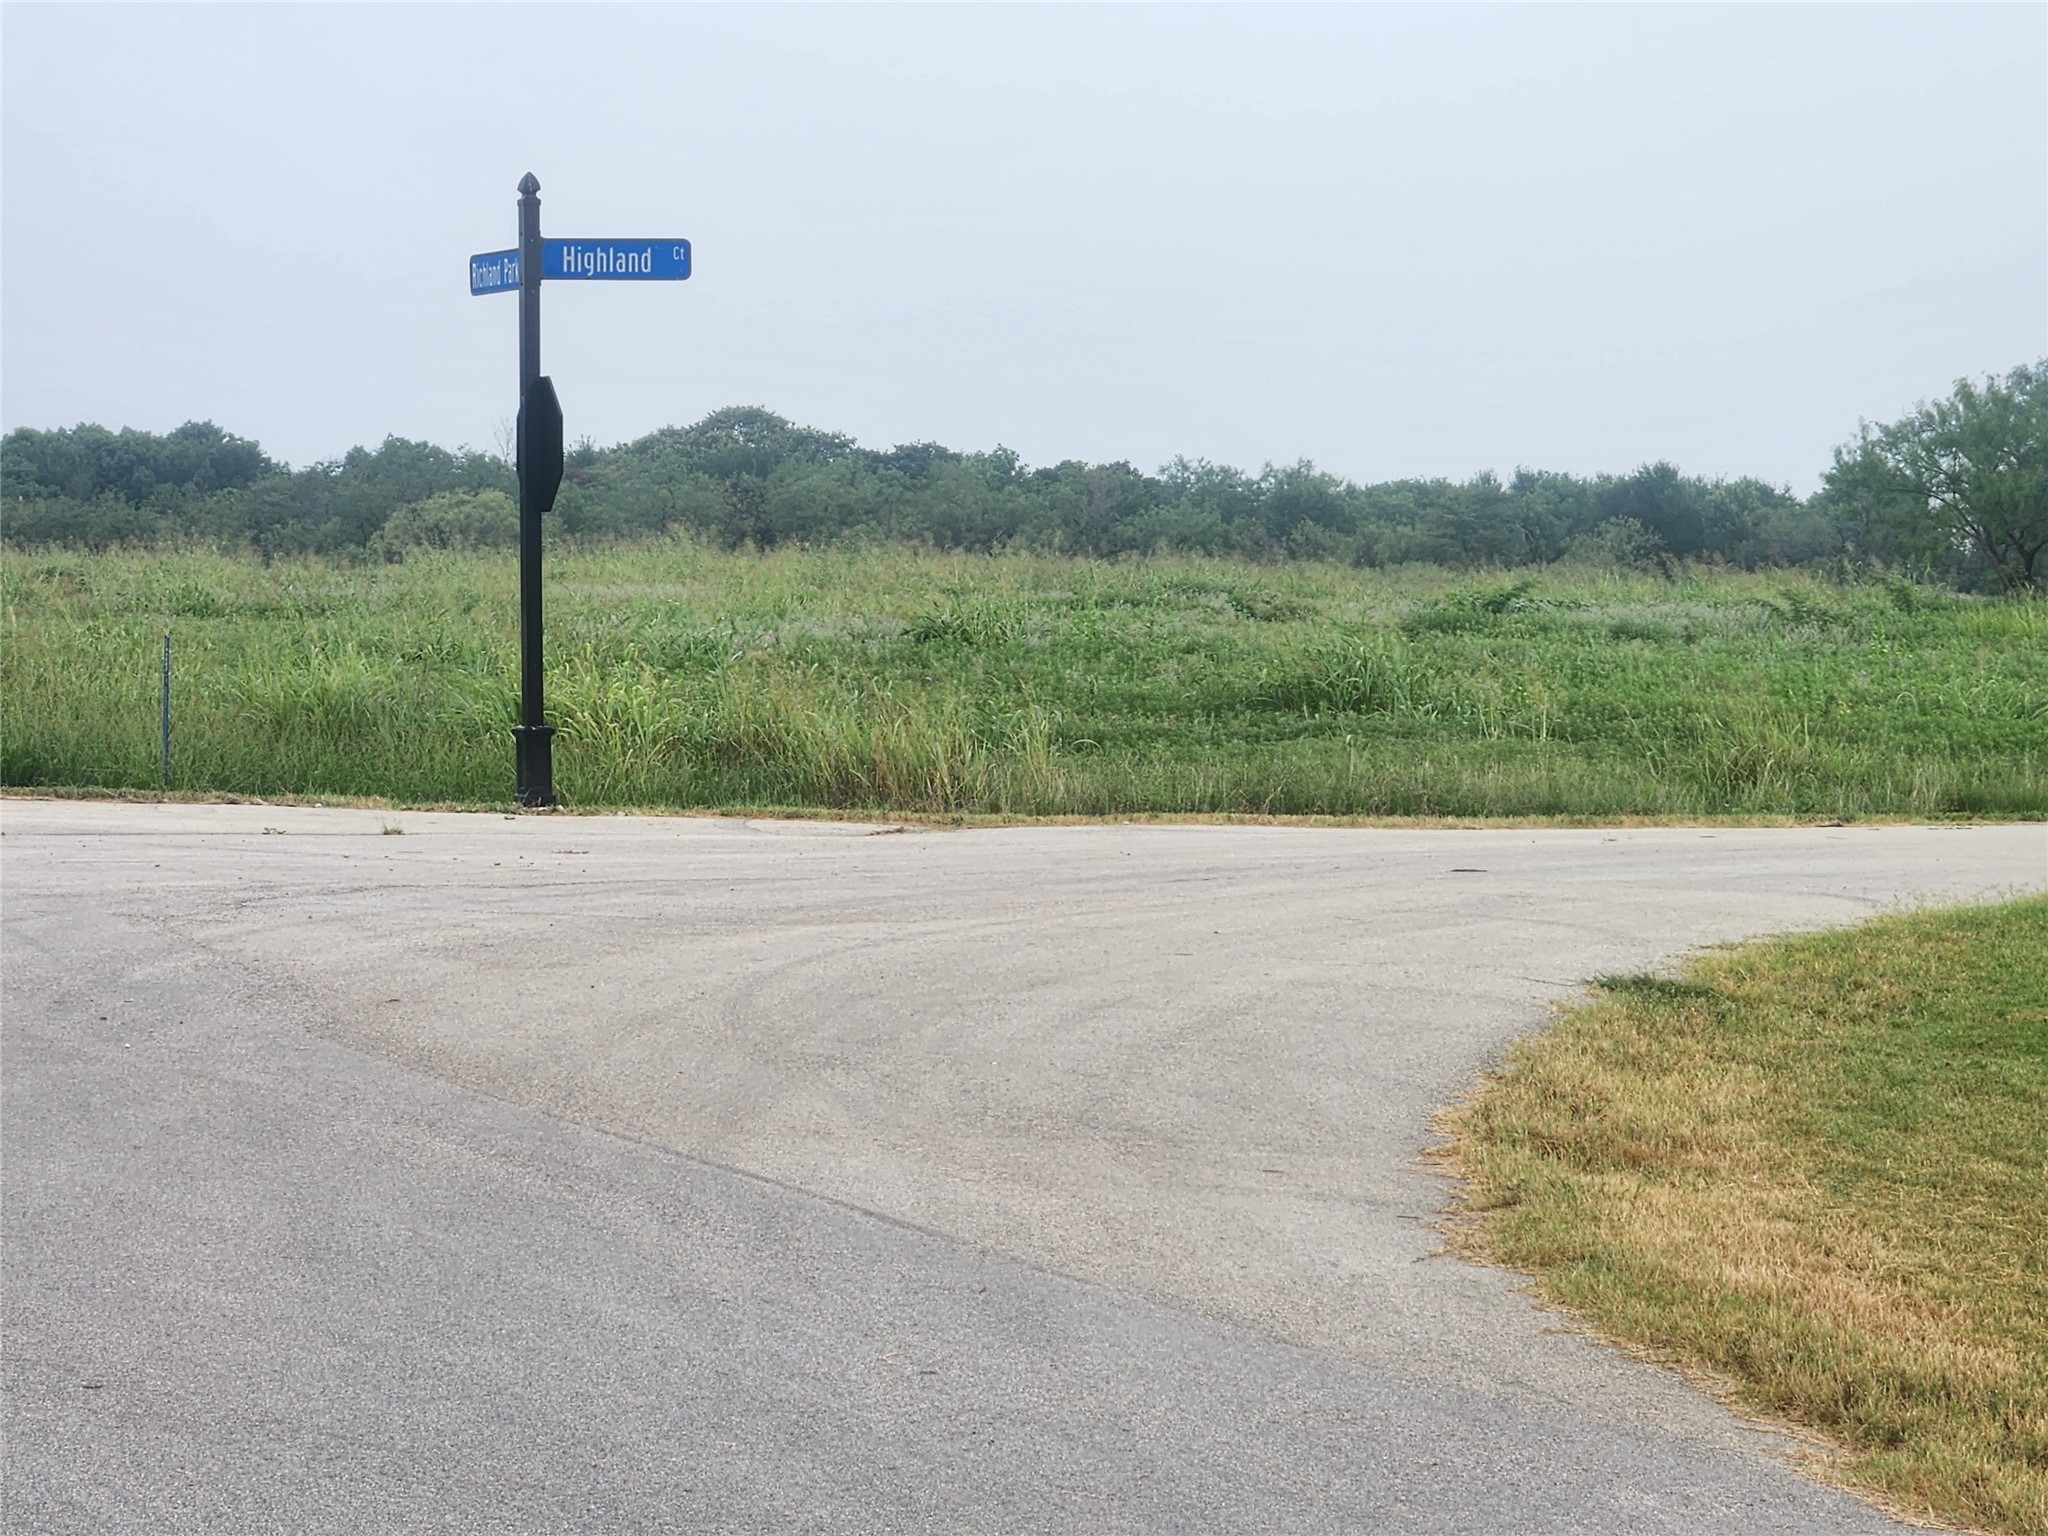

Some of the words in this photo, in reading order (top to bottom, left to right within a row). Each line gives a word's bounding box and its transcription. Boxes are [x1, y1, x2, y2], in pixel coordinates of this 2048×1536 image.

[472, 260, 501, 288] Richland
[503, 257, 519, 284] Park
[563, 246, 652, 276] Highland
[673, 246, 685, 260] Ct
